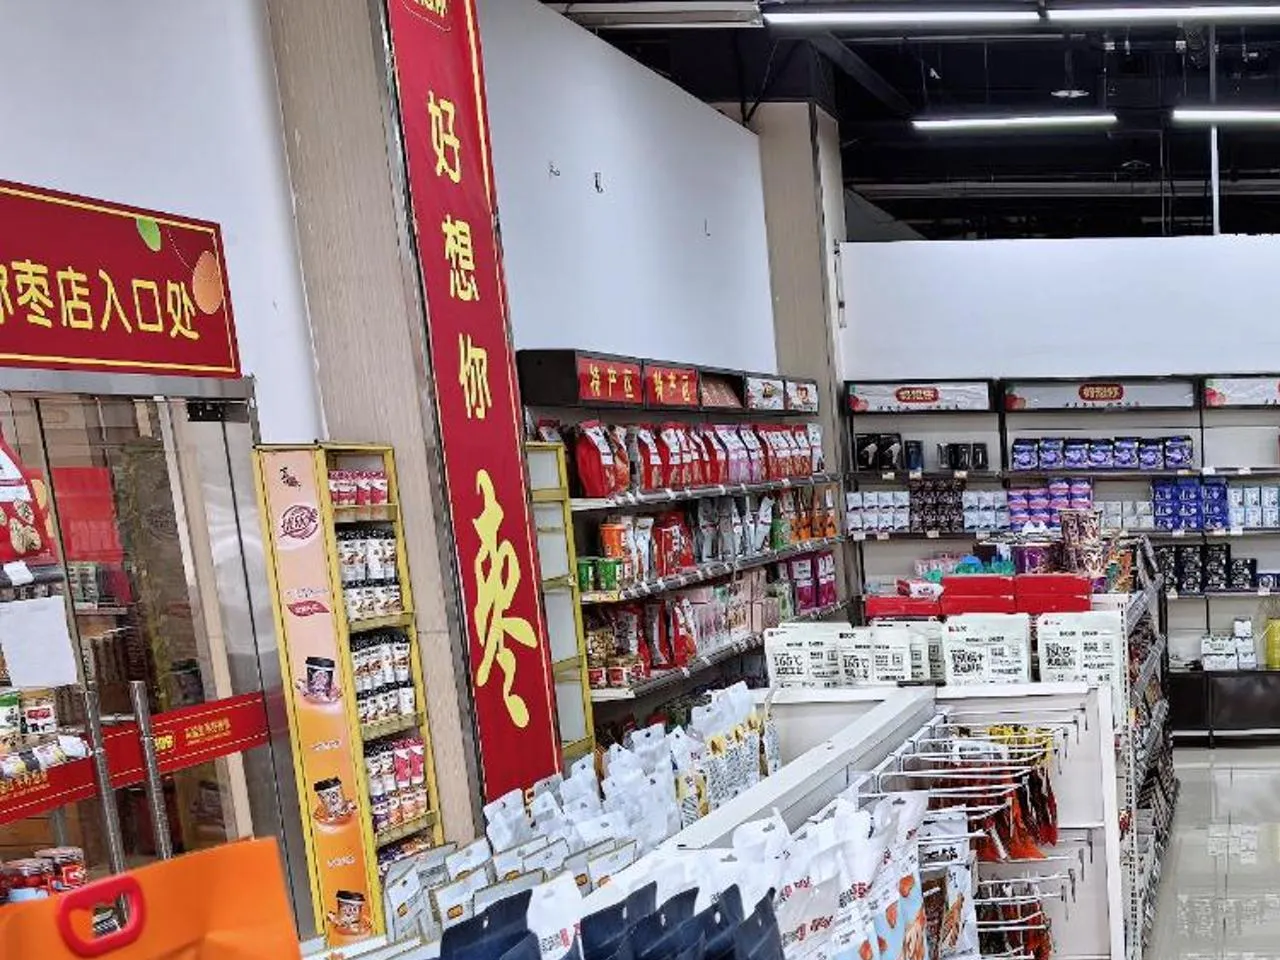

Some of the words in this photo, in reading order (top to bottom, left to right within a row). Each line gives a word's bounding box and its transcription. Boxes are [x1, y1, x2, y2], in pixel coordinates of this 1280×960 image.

[589, 363, 634, 399] 特产区
[1083, 385, 1120, 398] 好想你
